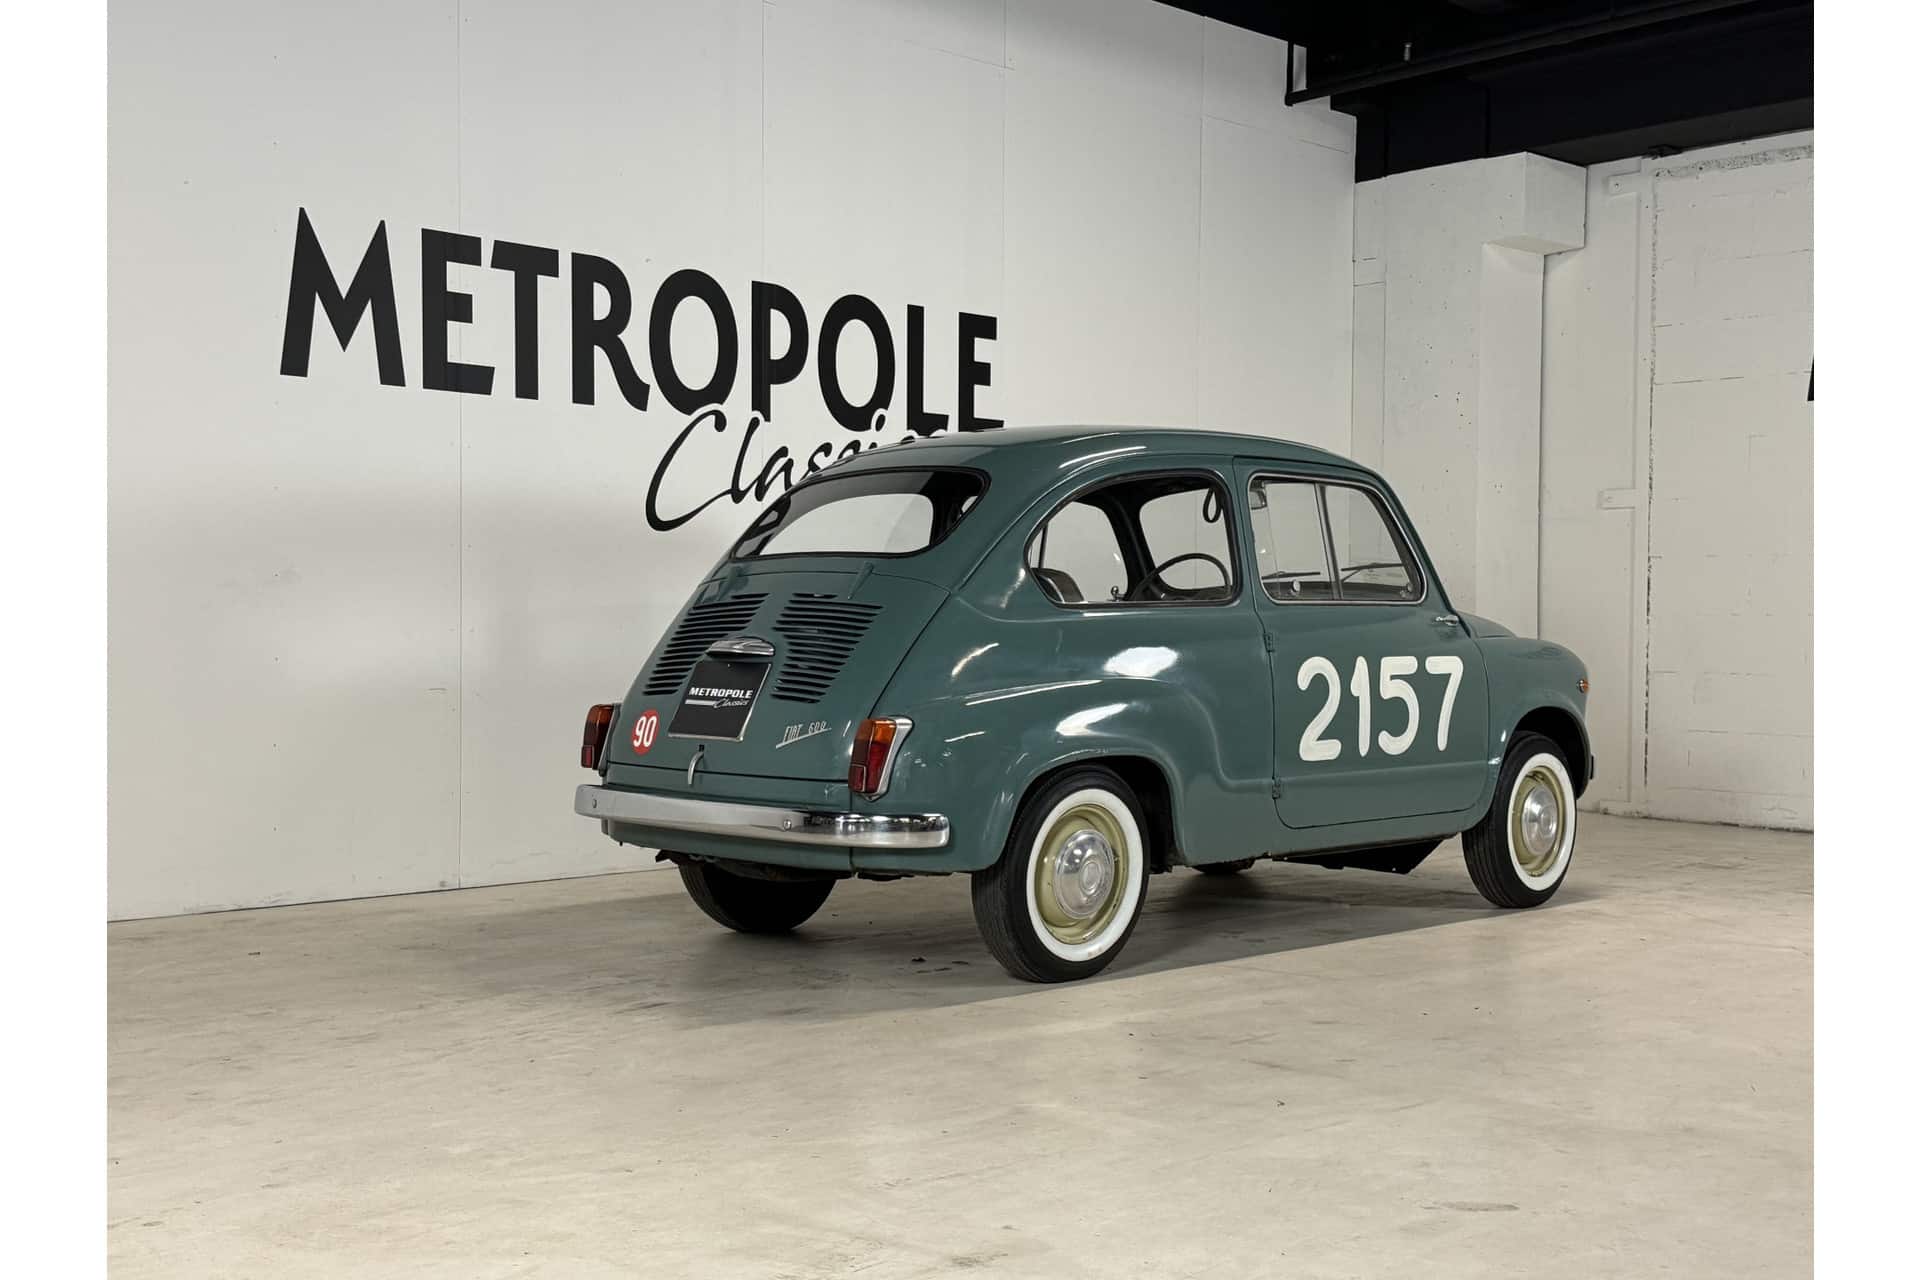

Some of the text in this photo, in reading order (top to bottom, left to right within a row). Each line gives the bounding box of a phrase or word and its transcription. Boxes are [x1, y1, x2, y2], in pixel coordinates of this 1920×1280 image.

[280, 207, 1005, 433] METROPOLE
[688, 687, 753, 699] METROPOLE
[713, 698, 749, 709] Classics
[1297, 655, 1464, 762] 2157
[633, 715, 658, 748] 90
[782, 720, 827, 744] FIAT 600
